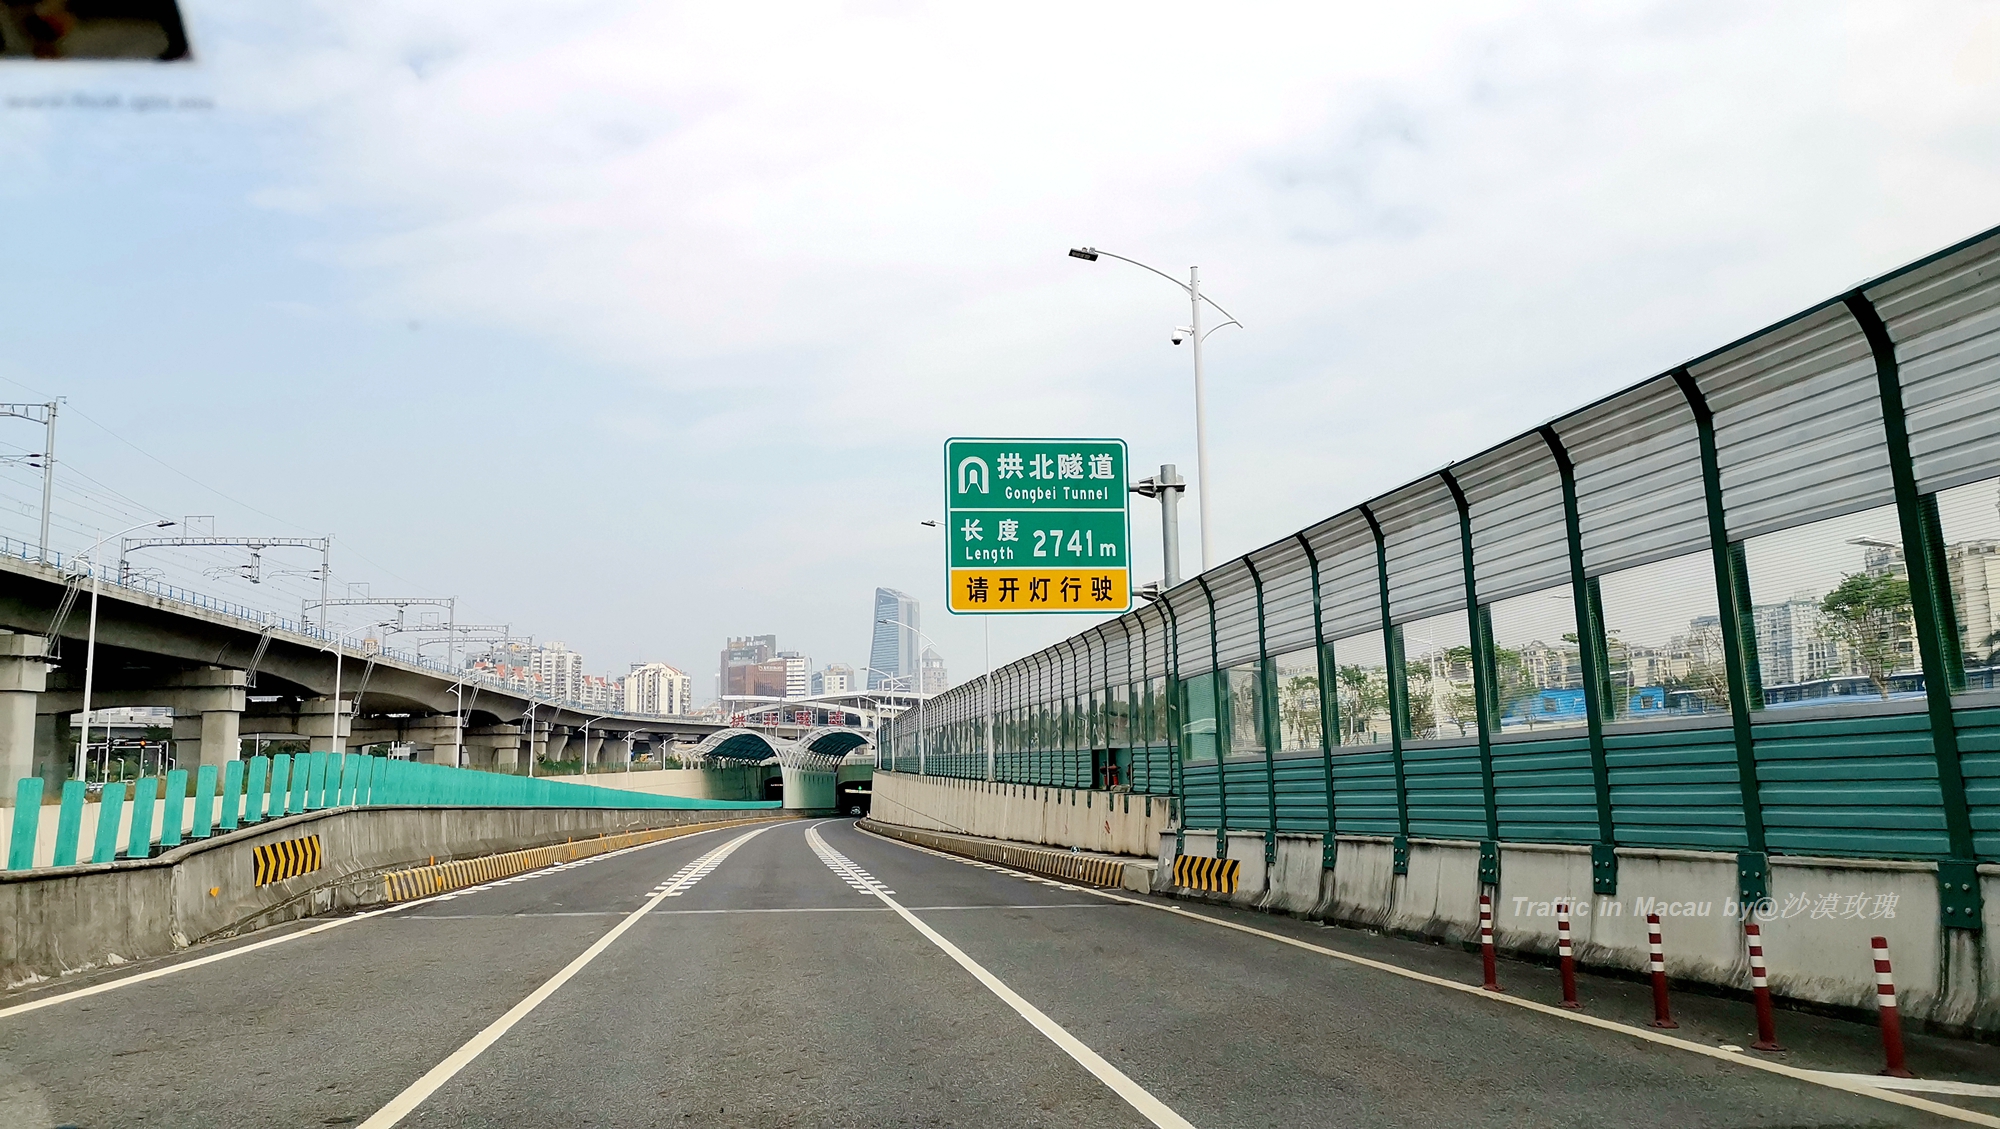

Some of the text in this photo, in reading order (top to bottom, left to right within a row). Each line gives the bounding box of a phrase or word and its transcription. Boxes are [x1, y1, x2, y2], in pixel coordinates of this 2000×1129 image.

[997, 453, 1115, 480] 拱北隧道
[1005, 486, 1108, 503] Gongbei Tunnel
[961, 519, 1019, 542] 长度
[965, 547, 1014, 563] Length
[966, 575, 1113, 602] 请开灯行驶
